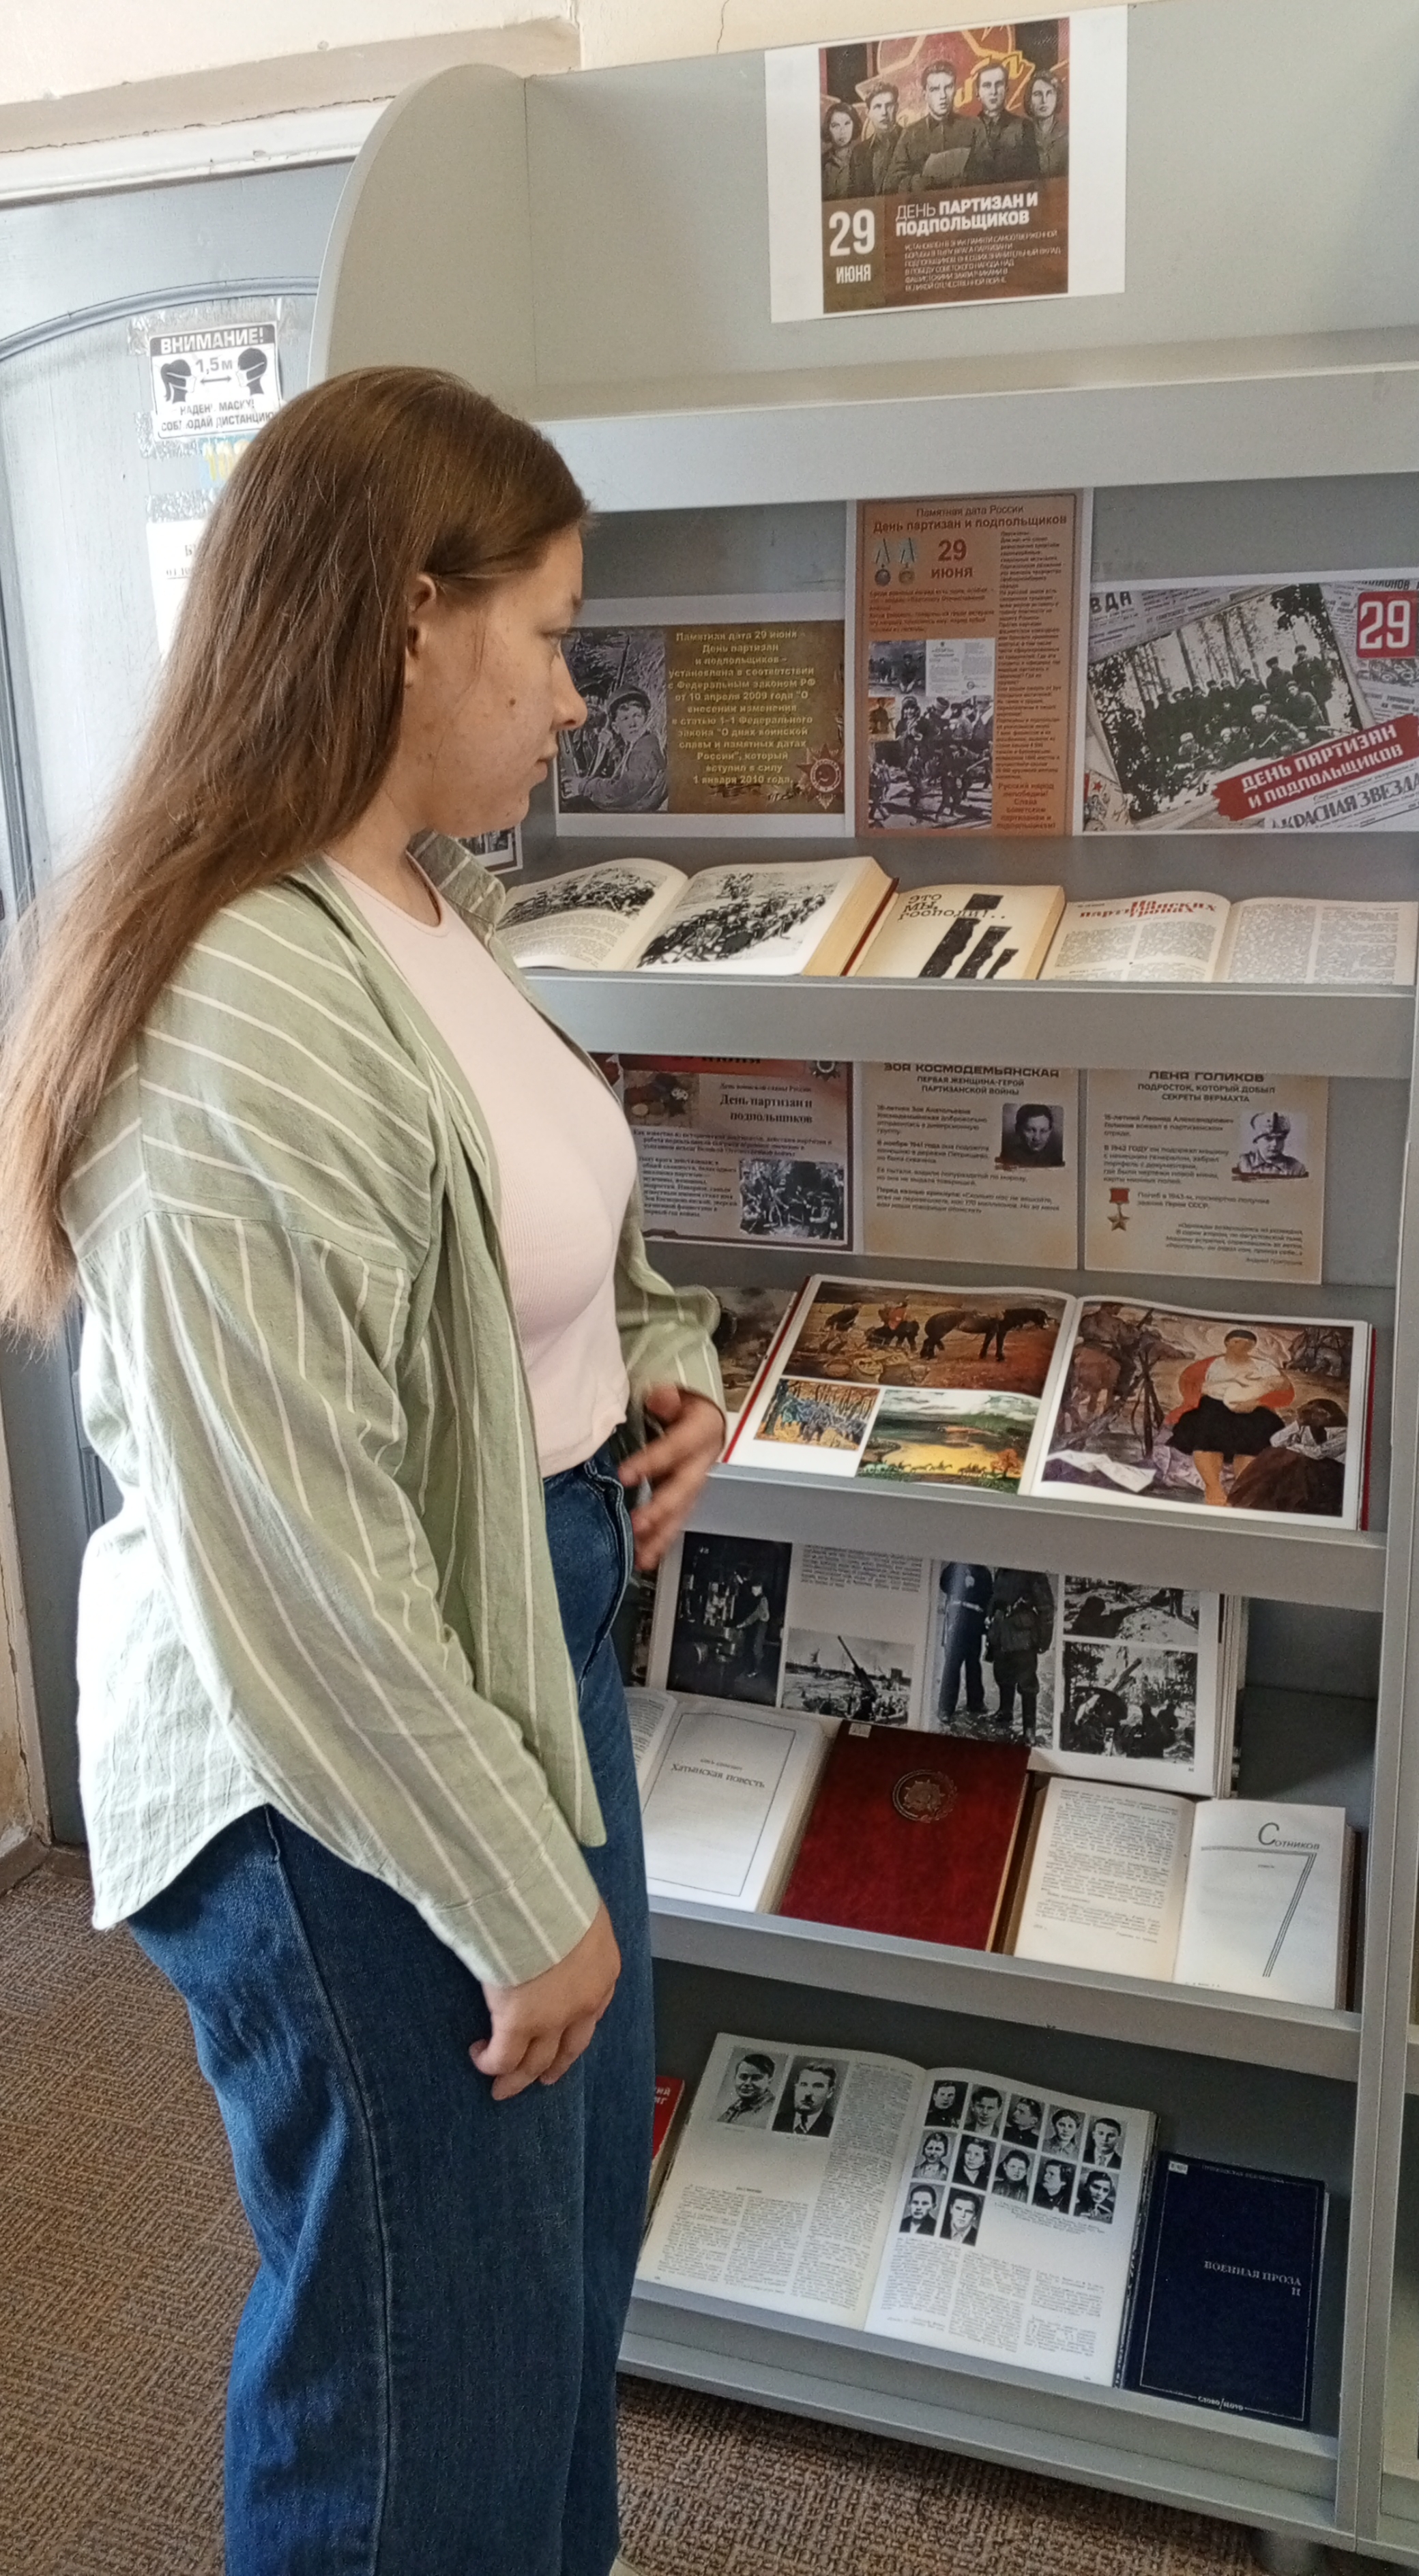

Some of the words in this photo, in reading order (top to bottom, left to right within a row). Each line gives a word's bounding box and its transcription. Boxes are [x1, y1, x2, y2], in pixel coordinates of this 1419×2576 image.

[896, 204, 936, 222] ДЕНЬ
[939, 193, 1023, 216] ПАРТИЗАН
[1026, 192, 1038, 207] И
[896, 210, 1029, 237] ПОДПОЛЬЩИКОВ
[829, 209, 875, 257] 29
[836, 264, 871, 284] ИЮНЯ
[160, 327, 264, 354] ВНИМАНИЕ!
[195, 357, 219, 375] 1,5
[180, 403, 216, 415] НАДЕН
[219, 400, 254, 412] МАСКУ!
[162, 416, 213, 431] СОБЮДАЙ
[916, 508, 963, 517] Памятная
[965, 508, 986, 517] дата
[990, 505, 1023, 516] России
[873, 521, 903, 533] День
[907, 518, 961, 533] партизан
[965, 520, 972, 529] и
[976, 515, 1067, 529] подпольщиков
[938, 539, 967, 562] 29
[1359, 600, 1411, 649] 29
[729, 632, 751, 641] дата
[703, 645, 728, 654] День
[731, 645, 778, 654] партизан
[704, 657, 779, 665] подпольщиков
[800, 678, 815, 686] РФ
[770, 692, 793, 701] года
[739, 716, 813, 725] Федерального
[777, 740, 806, 748] датах
[745, 752, 788, 761] который
[1240, 763, 1292, 794] ДЕНЬ
[1294, 724, 1397, 772] ПАРТИЗАН
[693, 776, 698, 784] 1
[1248, 794, 1262, 810] И
[1264, 744, 1403, 804] ПОДПОЛЬЩИКОВ
[883, 1062, 911, 1072] ЗОЯ
[916, 1064, 1059, 1078] КОСМОДЕМЬЯНСКАЯ
[1149, 1072, 1189, 1080] ЛЕНЯ
[1195, 1072, 1264, 1082] ГОЛИКОВ
[951, 1077, 1024, 1086] ЖЕНЩИНА-ГЕРОЙ
[1138, 1083, 1194, 1092] ПОДРОСТОК,
[922, 1085, 986, 1095] ПАРТИЗАНСКОЙ
[720, 1094, 748, 1105] День
[750, 1098, 802, 1108] партизан
[806, 1100, 812, 1108] и
[731, 1112, 813, 1123] подпольщиков
[671, 1763, 723, 1779] Хатынская
[726, 1774, 765, 1787] повесть
[1204, 2261, 1260, 2279] ВОЕННАЯ
[1262, 2272, 1302, 2286] ПРОЗА
